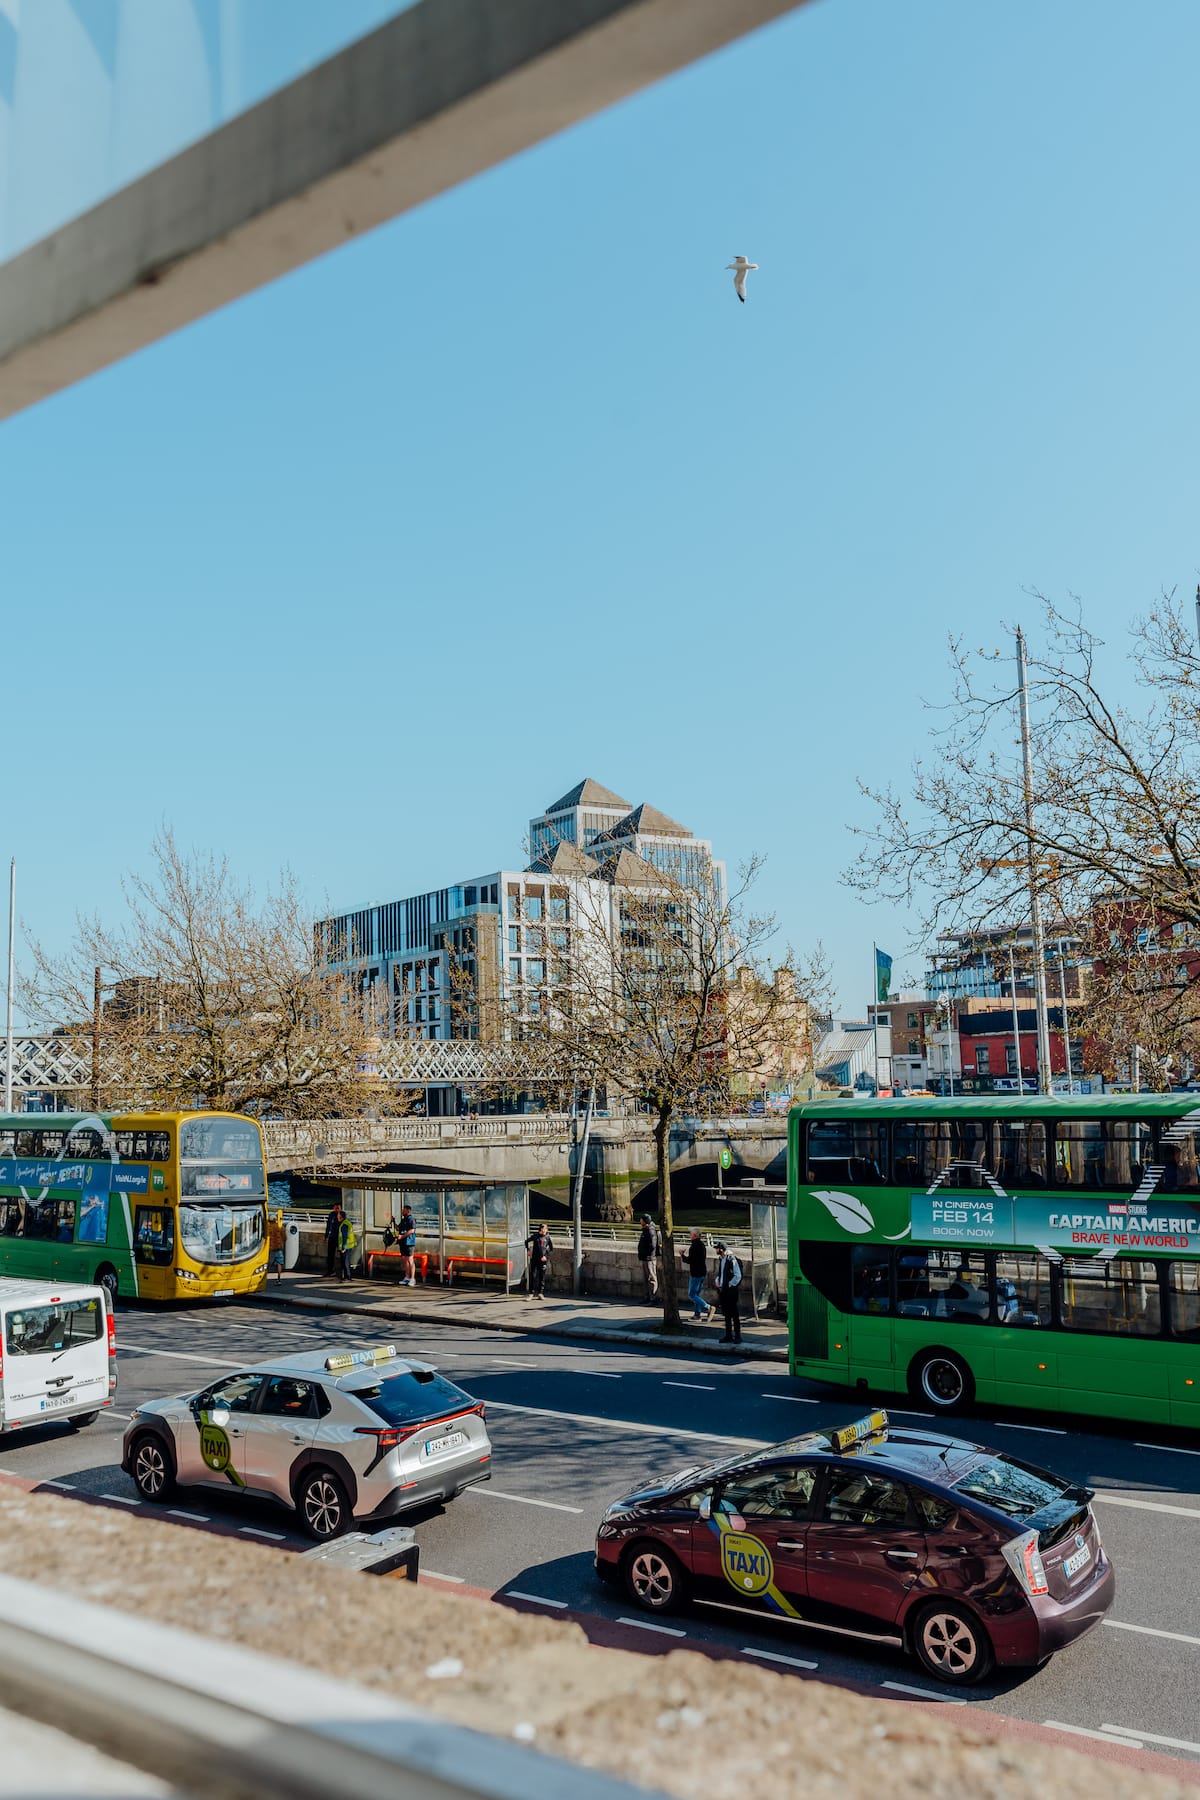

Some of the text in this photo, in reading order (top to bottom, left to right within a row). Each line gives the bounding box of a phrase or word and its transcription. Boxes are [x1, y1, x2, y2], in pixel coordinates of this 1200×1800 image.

[153, 1175, 164, 1185] TFI
[932, 1200, 994, 1210] IN CINEMAS
[1109, 1205, 1148, 1215] MARVEL STUDIOS
[932, 1210, 995, 1224] FEB 14
[1049, 1214, 1200, 1234] CAPTAIN AMERIC
[933, 1227, 995, 1237] BOOK NOW
[1072, 1232, 1189, 1248] BRAVE NEW WORLD
[353, 1350, 374, 1364] TAXI
[204, 1438, 226, 1457] TAXI
[727, 1550, 766, 1576] TAXI
